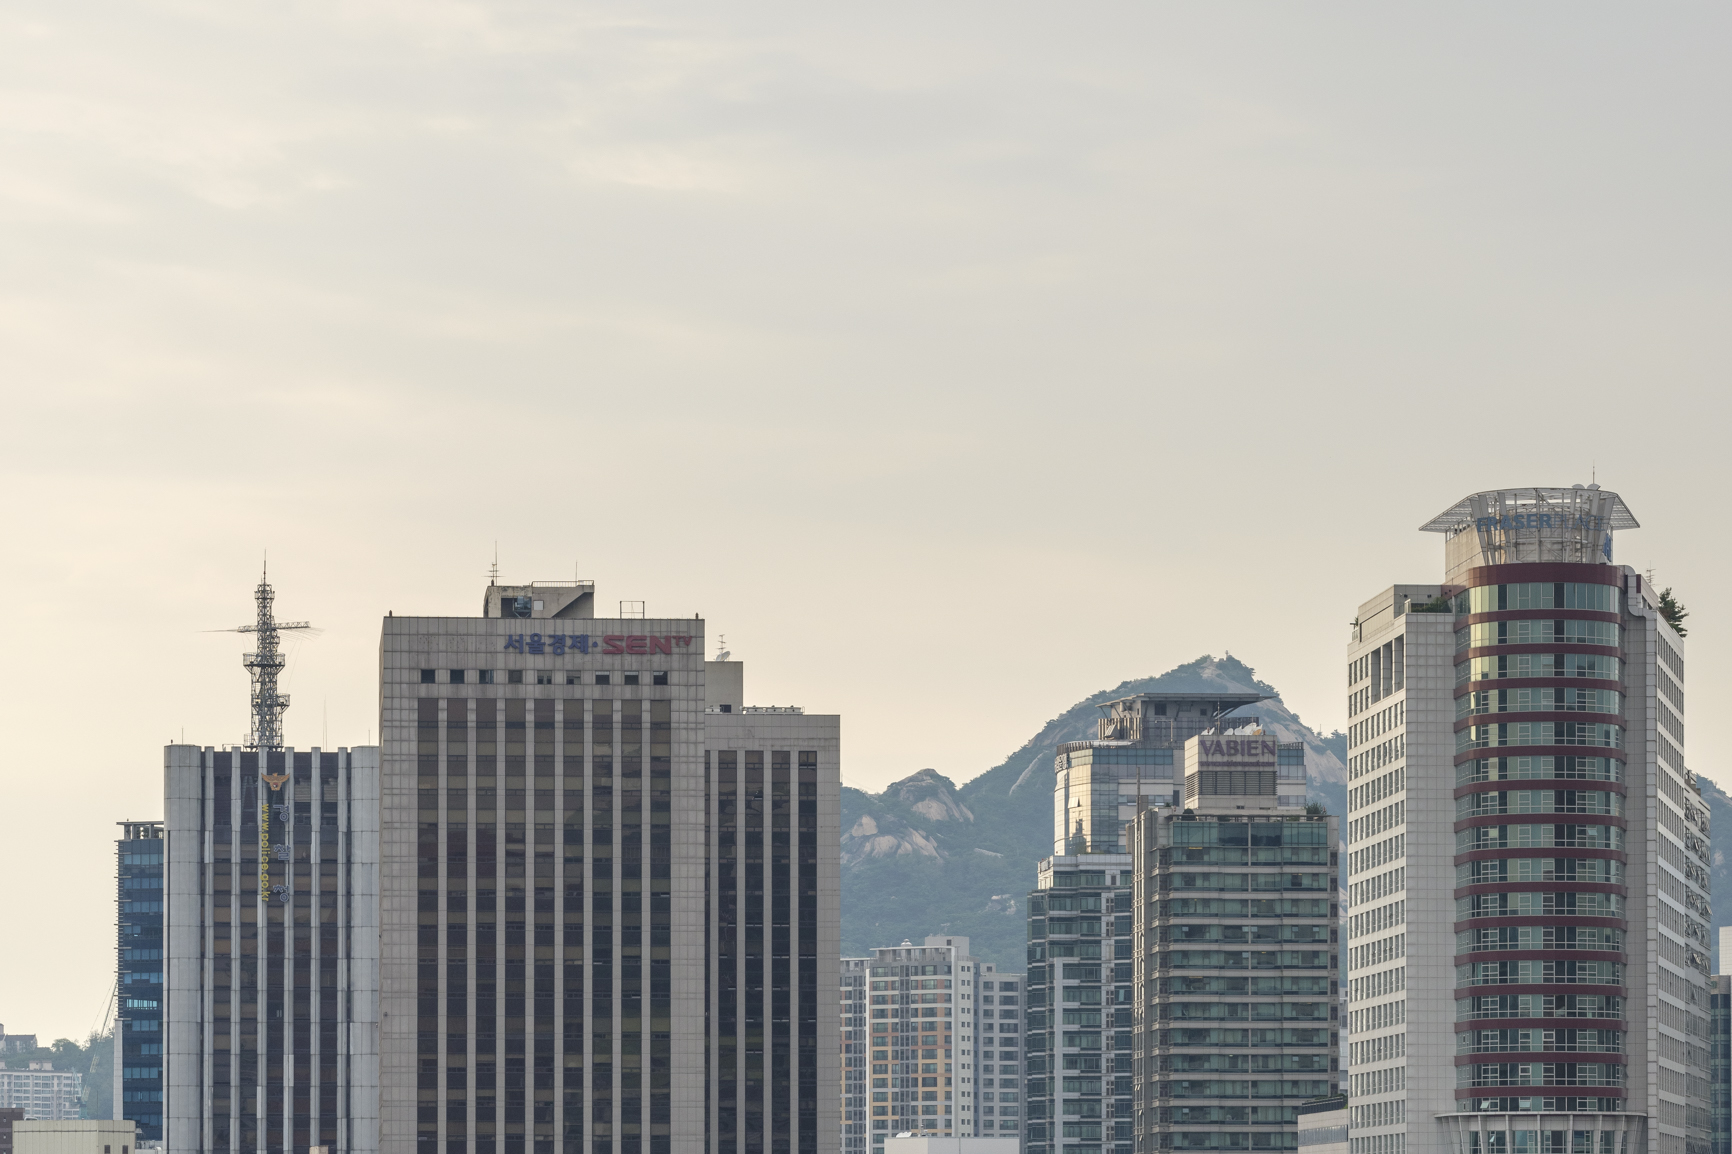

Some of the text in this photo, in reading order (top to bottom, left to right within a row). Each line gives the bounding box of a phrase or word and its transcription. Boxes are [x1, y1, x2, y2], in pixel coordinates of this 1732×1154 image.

[1477, 514, 1551, 532] FRASER
[1200, 739, 1276, 757] VABIEN
[260, 804, 270, 901] www.police.go.kr
[273, 804, 290, 902] 경찰청
